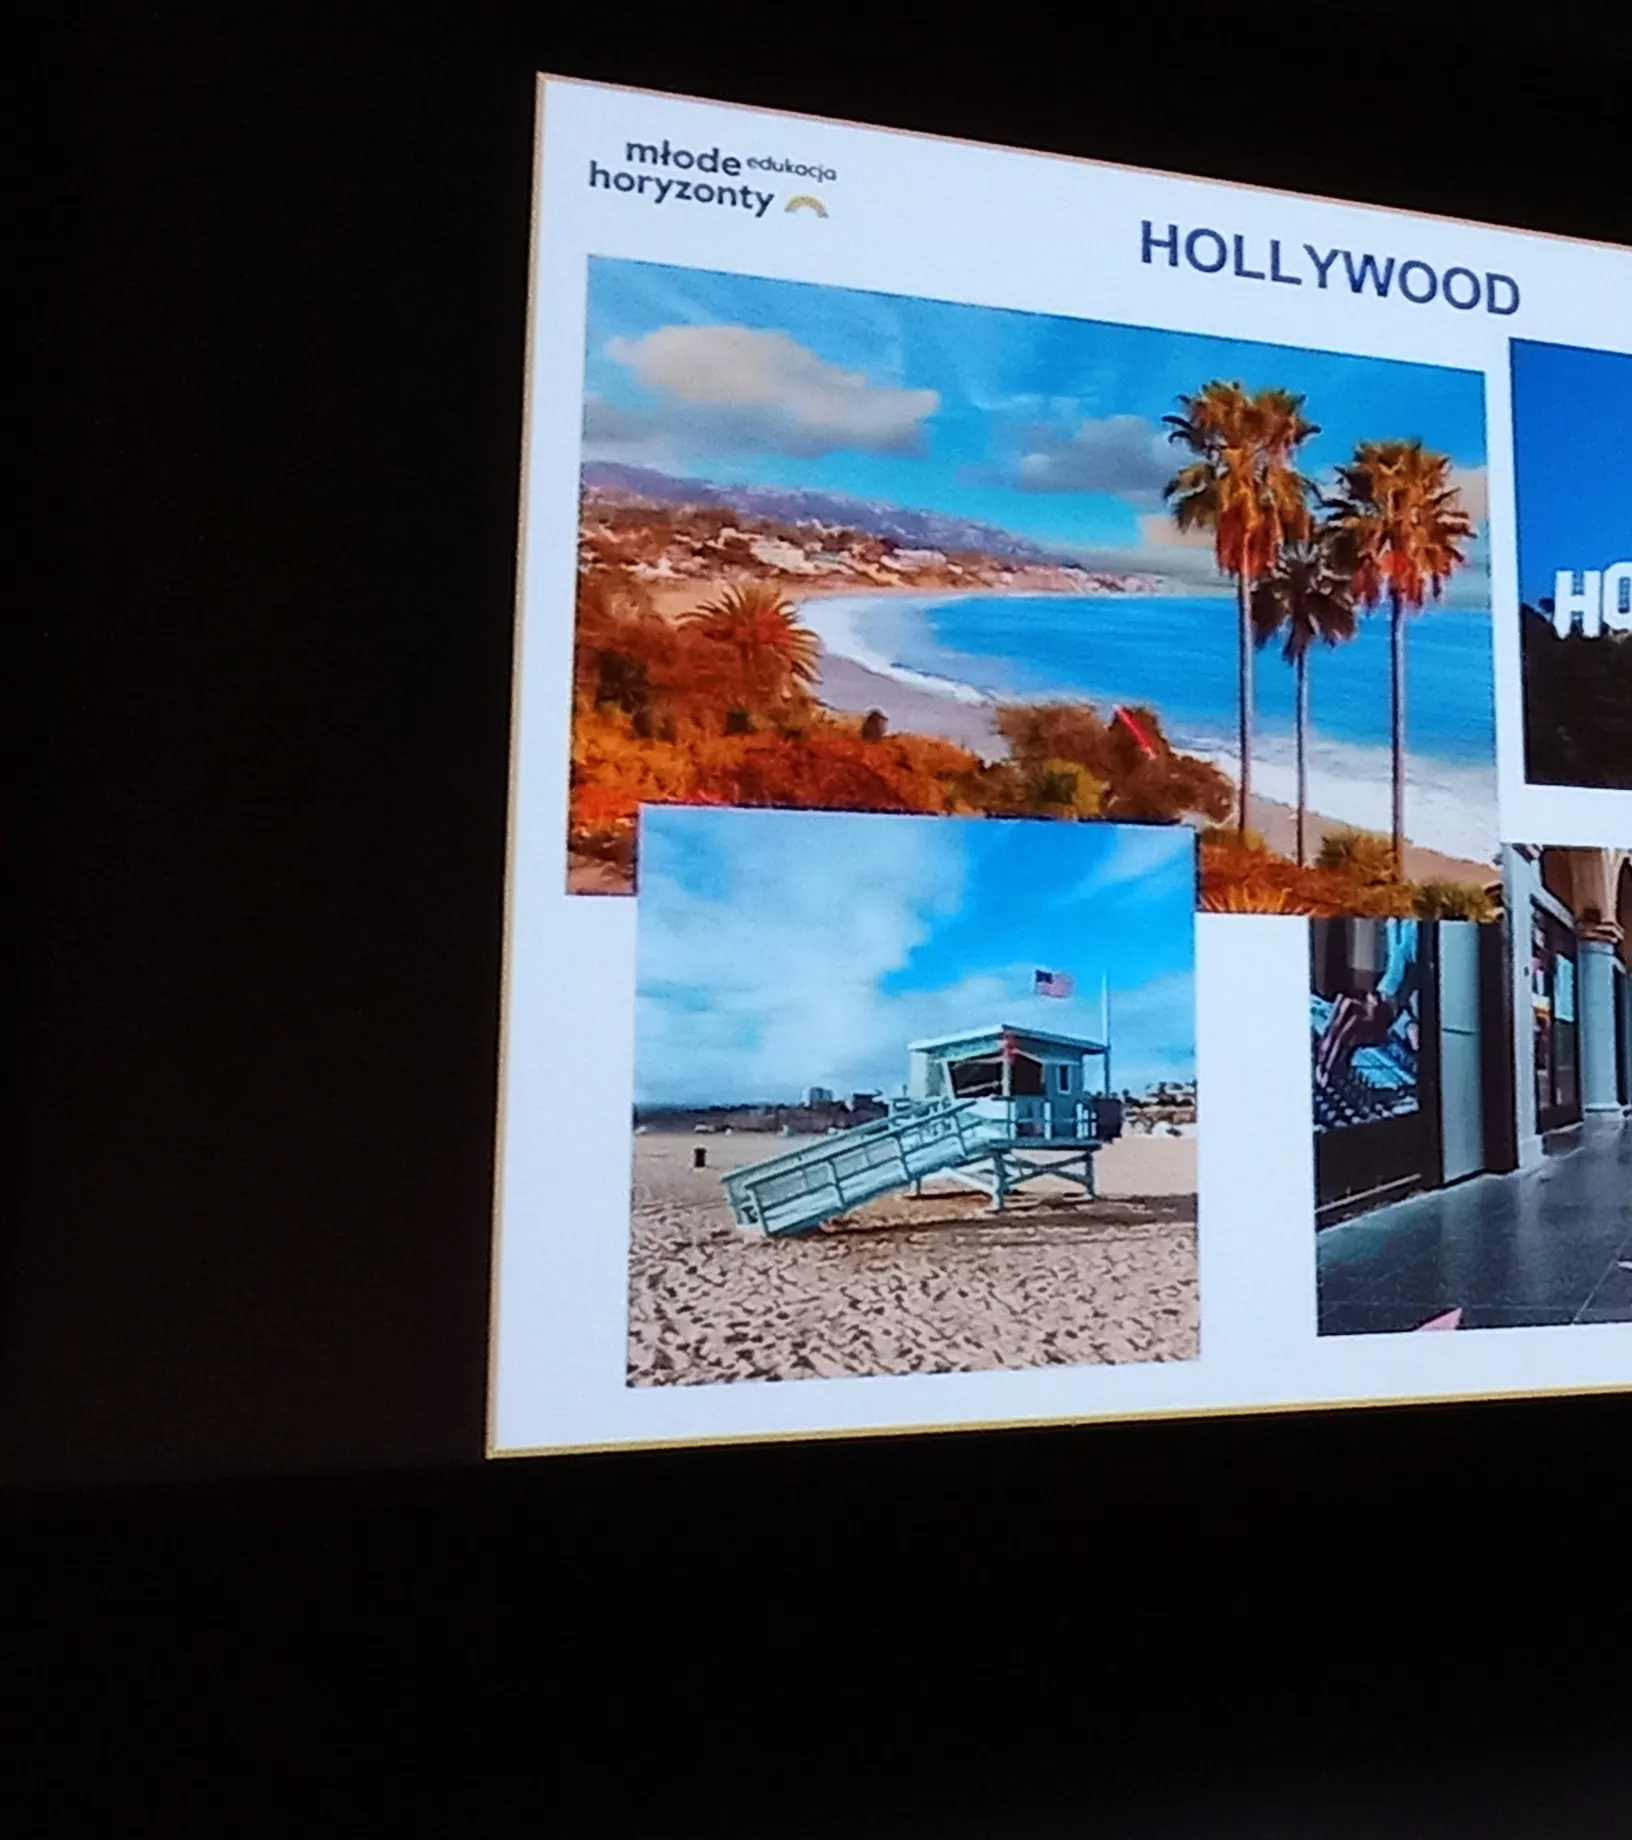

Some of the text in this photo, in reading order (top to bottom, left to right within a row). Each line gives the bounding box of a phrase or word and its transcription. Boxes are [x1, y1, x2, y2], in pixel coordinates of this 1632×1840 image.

[625, 139, 741, 176] młode
[588, 160, 774, 217] horyzonty
[1141, 220, 1520, 315] HOLLYWOOD
